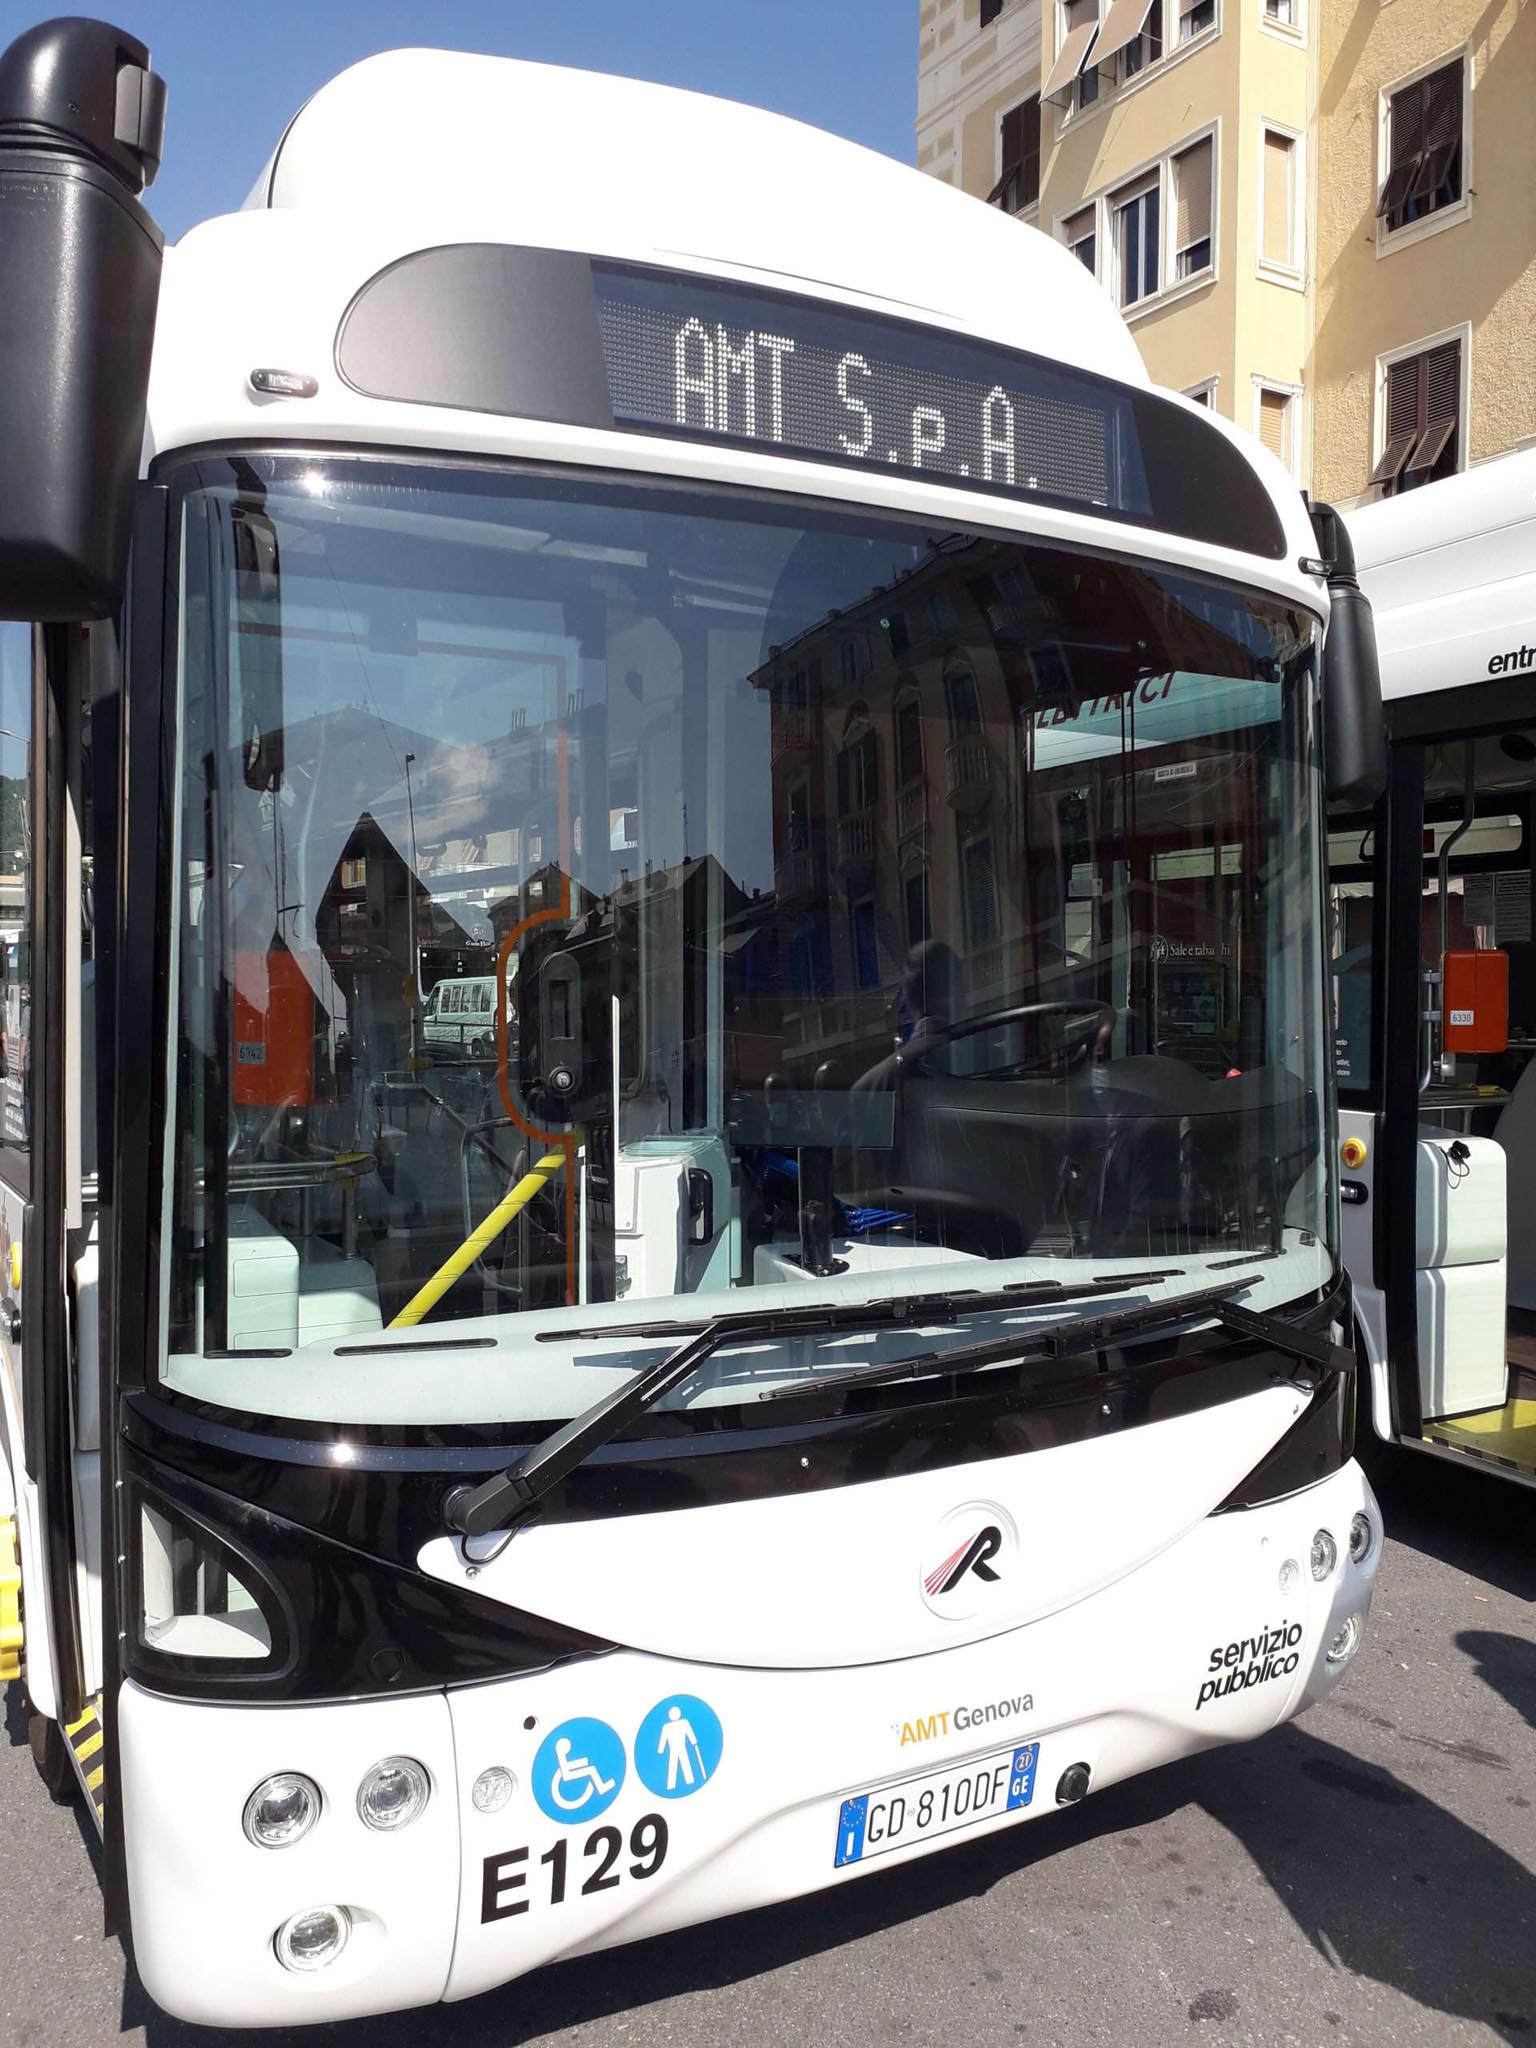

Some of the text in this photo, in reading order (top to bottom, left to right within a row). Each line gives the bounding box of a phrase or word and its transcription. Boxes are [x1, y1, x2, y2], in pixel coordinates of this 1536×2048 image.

[675, 317, 1038, 488] AMT S.p.A.
[1195, 942, 1231, 957] tabachi
[1452, 1013, 1472, 1023] 6330
[1208, 1619, 1303, 1673] servizio
[1195, 1652, 1299, 1711] pubblico
[900, 1693, 1034, 1747] AMT Genova
[1011, 1774, 1030, 1797] GE
[1017, 1753, 1031, 1770] 21
[480, 1812, 669, 1925] E129
